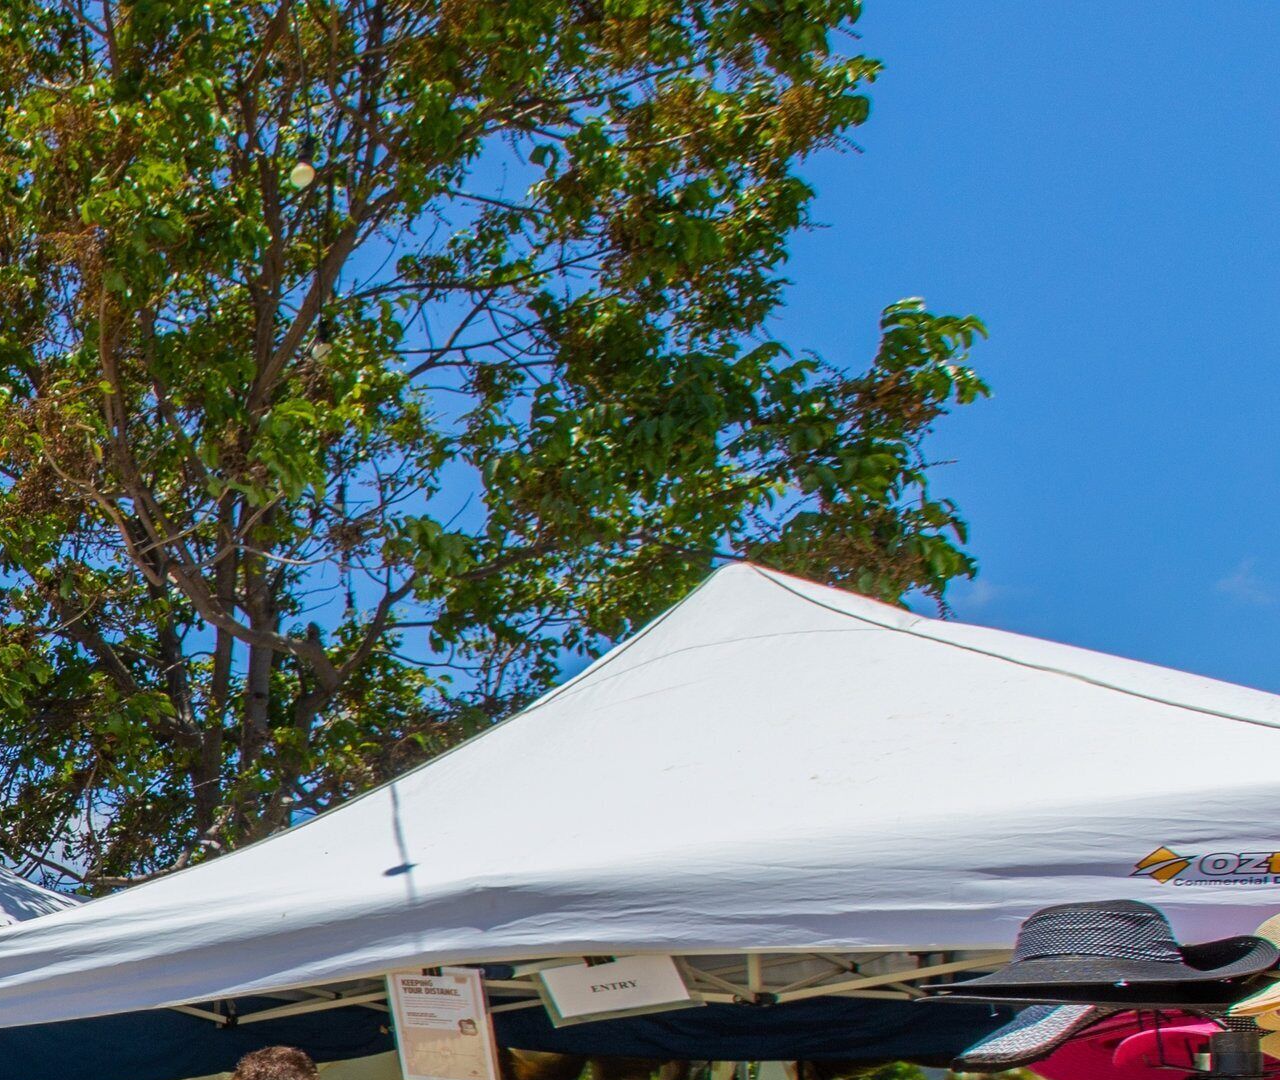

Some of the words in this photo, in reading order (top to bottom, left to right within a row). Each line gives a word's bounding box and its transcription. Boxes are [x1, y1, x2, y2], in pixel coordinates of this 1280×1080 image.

[1173, 877, 1267, 887] Commercial
[401, 979, 433, 987] KEEPING
[591, 980, 638, 993] ENTRY
